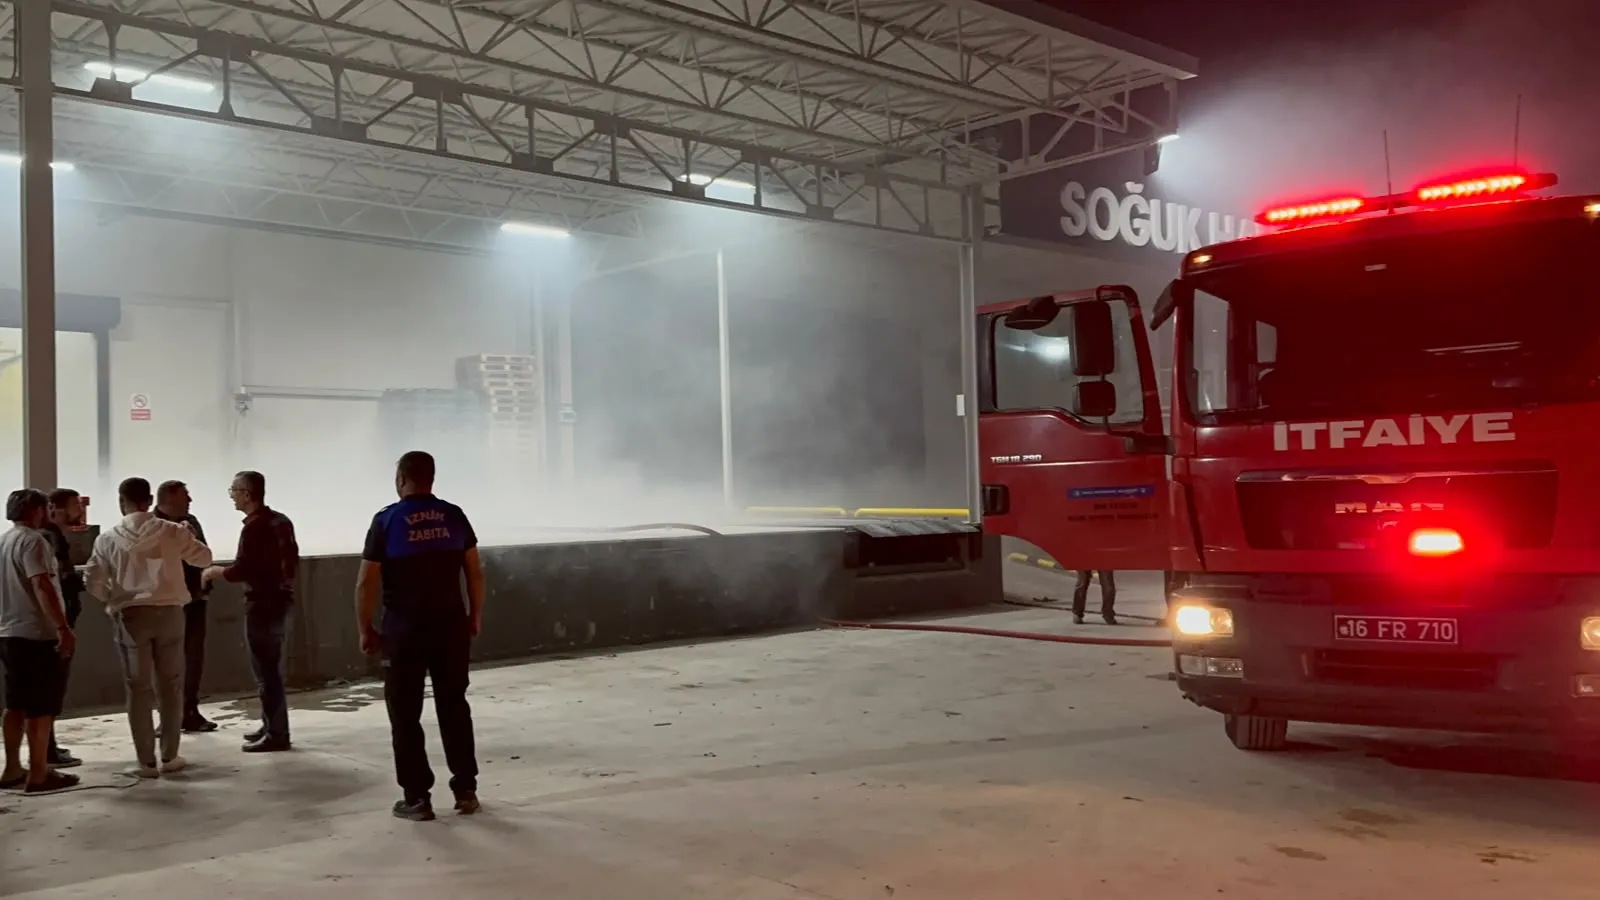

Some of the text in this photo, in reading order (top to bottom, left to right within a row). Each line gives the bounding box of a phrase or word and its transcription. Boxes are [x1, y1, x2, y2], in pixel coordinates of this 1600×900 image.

[1060, 181, 1202, 254] SOĞUK
[1273, 412, 1516, 451] İTFAİYE
[1347, 619, 1453, 640] 16 FR 710
